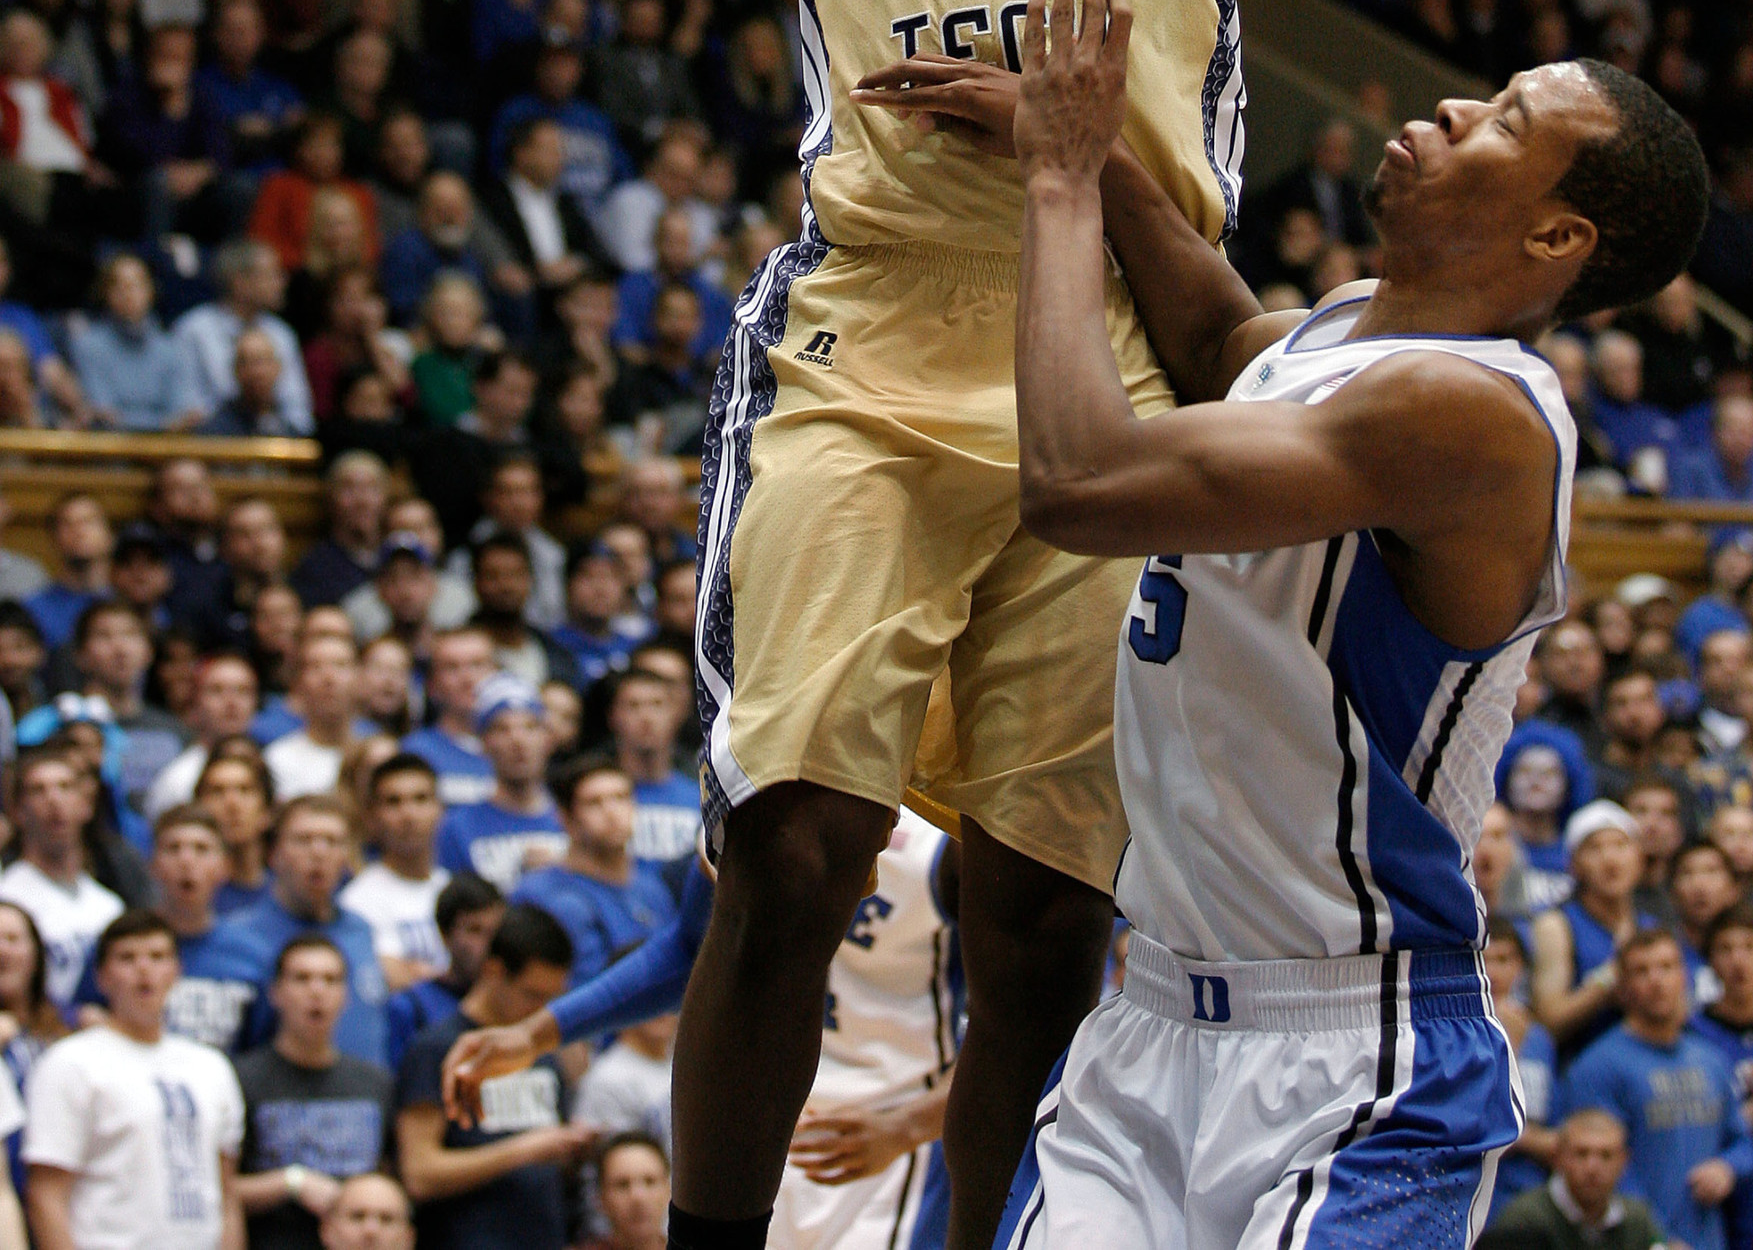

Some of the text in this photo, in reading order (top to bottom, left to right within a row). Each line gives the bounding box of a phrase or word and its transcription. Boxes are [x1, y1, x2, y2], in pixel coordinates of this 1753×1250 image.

[803, 330, 838, 356] R
[793, 351, 834, 367] RUSSELL
[1127, 554, 1189, 666] 5
